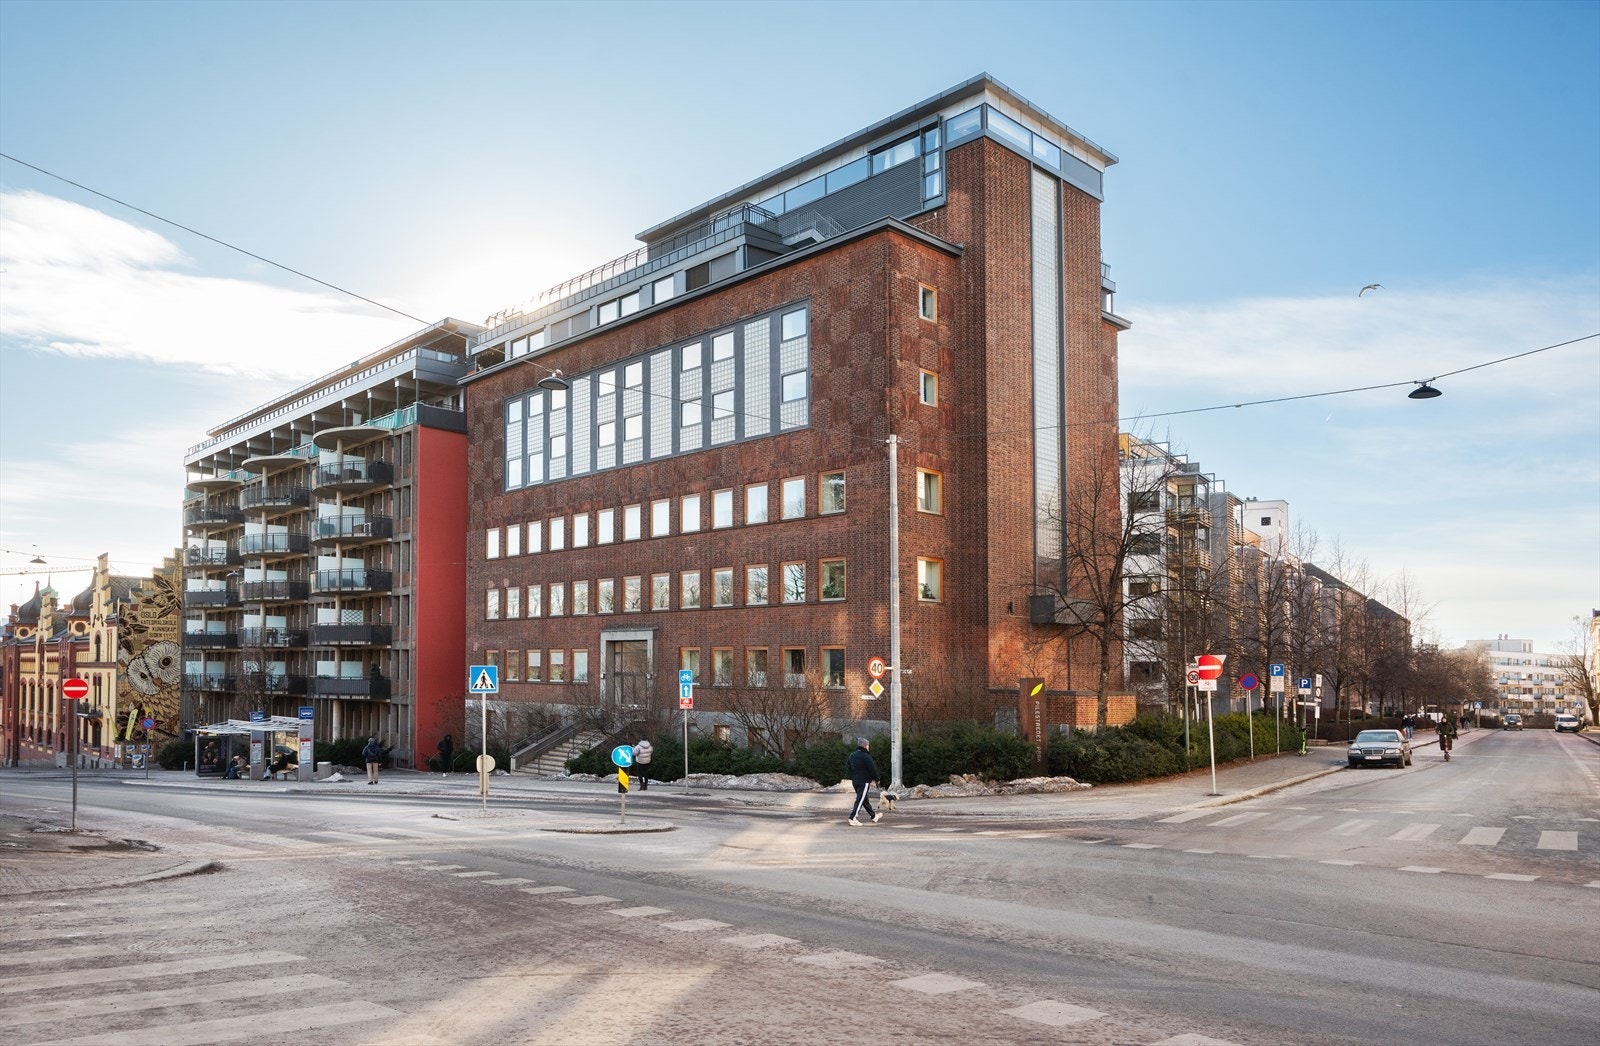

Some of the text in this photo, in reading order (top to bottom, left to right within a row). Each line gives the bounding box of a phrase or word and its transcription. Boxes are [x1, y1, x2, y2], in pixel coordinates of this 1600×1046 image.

[140, 611, 157, 619] OSLO
[871, 663, 883, 674] 40
[1273, 665, 1281, 675] P
[1301, 679, 1308, 688] P
[1034, 700, 1042, 742] PILESTREDET
